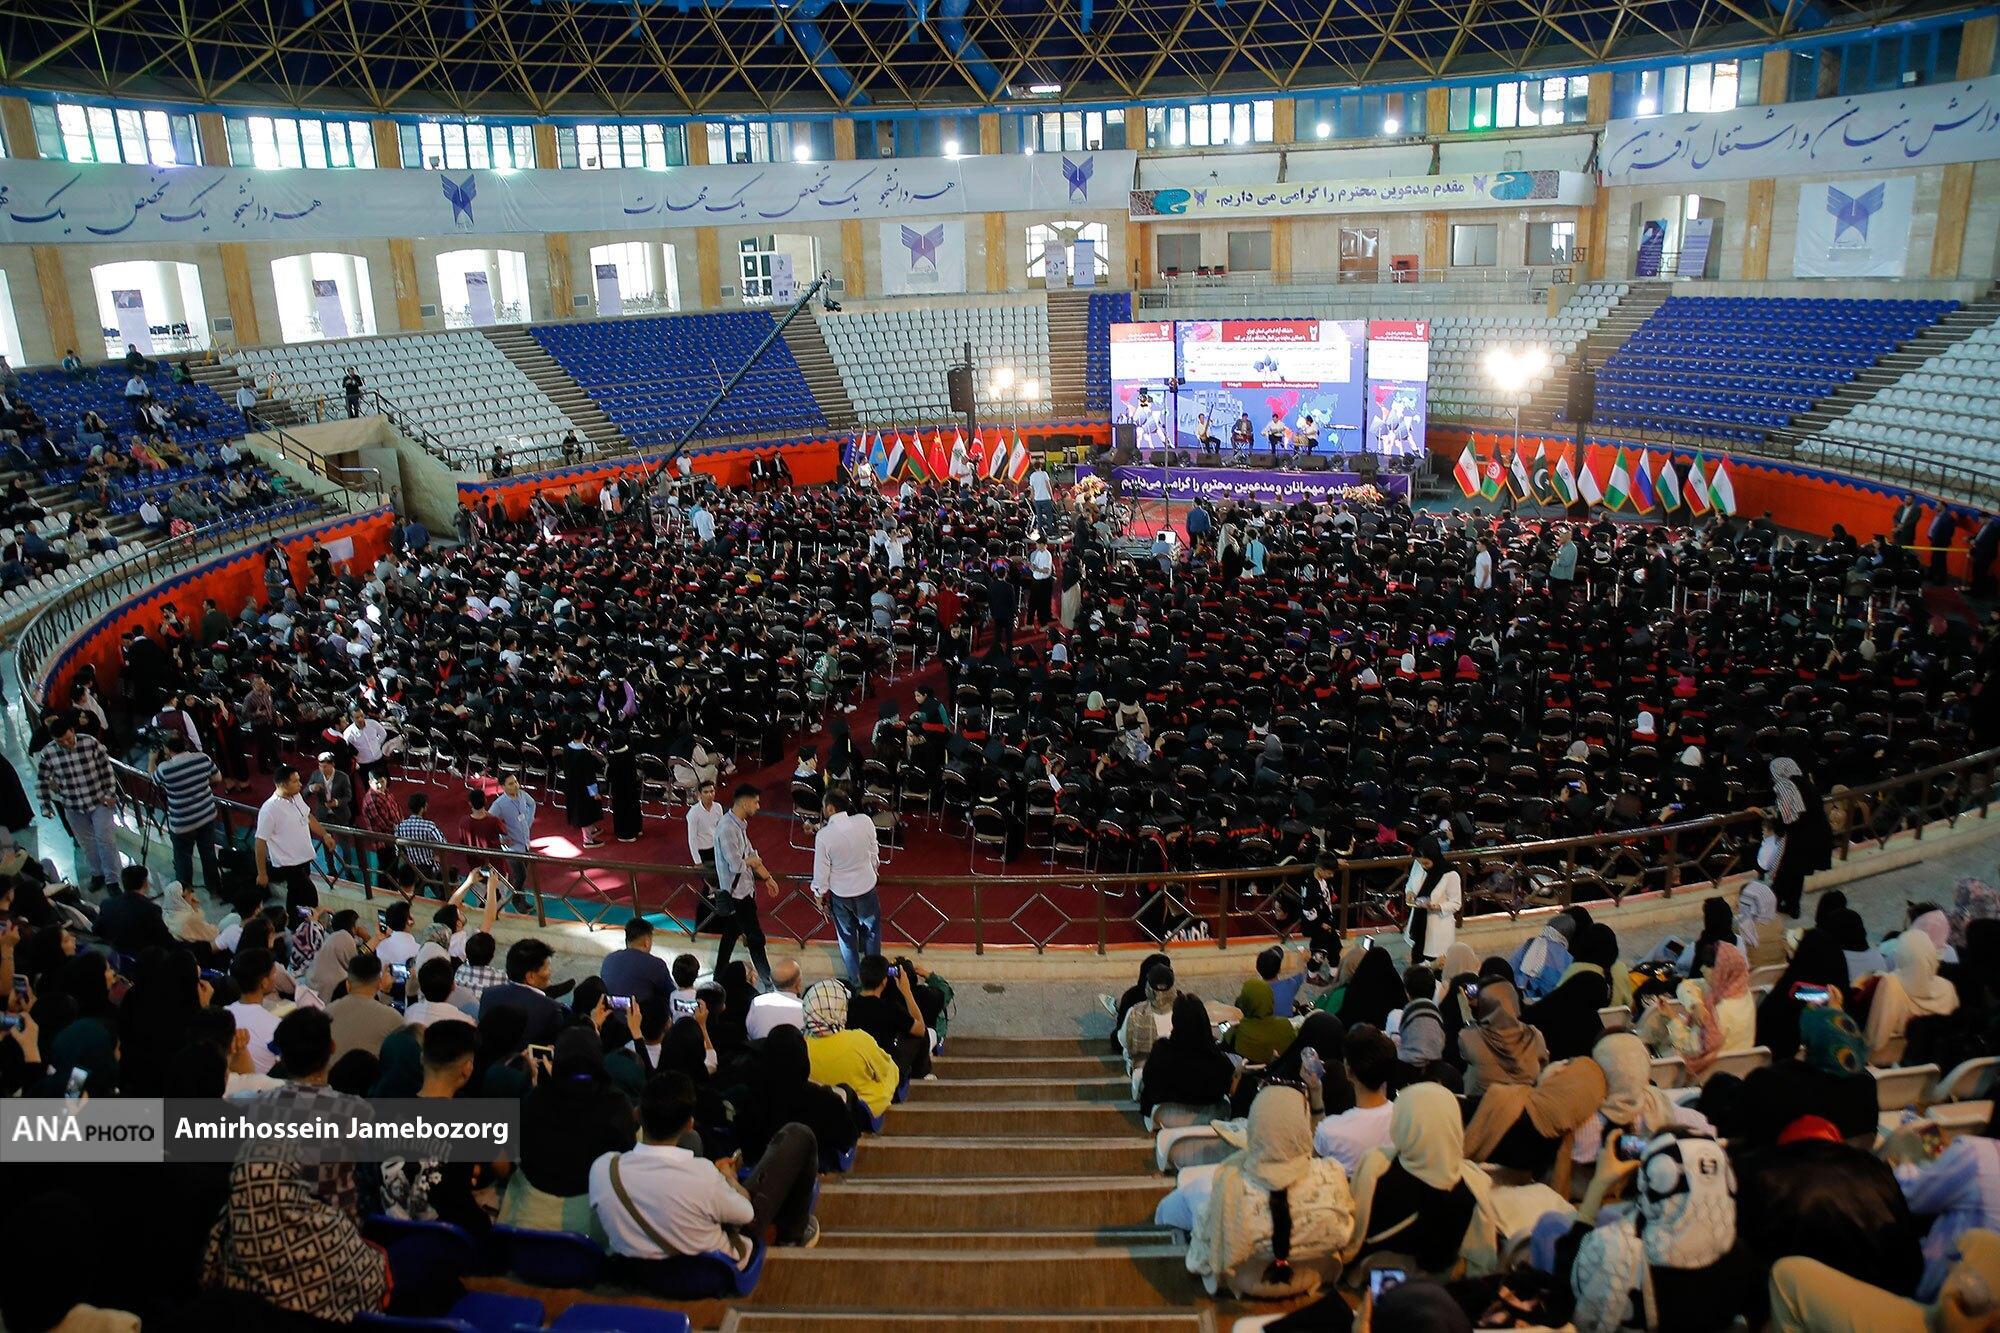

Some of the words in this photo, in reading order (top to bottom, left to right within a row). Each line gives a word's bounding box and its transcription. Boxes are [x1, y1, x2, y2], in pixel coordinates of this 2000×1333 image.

[1608, 120, 1702, 177] آفرین
[1690, 108, 1798, 170] اشتغال
[705, 172, 764, 219] یک
[818, 166, 877, 213] یک
[878, 167, 909, 209] دانشجو
[909, 182, 955, 203] هر
[1257, 193, 1276, 205] می
[1280, 187, 1319, 204] گرامی
[1323, 186, 1334, 202] را
[1338, 186, 1377, 201] محترم
[1380, 184, 1429, 199] مدعوین
[1433, 180, 1465, 197] مقدم
[10, 172, 82, 235] یک
[160, 174, 226, 232] یک
[233, 177, 269, 228] دانشجو
[270, 199, 322, 223] هر
[623, 186, 708, 215] مهارت
[1192, 478, 1200, 493] را
[1201, 479, 1232, 493] محترم
[1284, 480, 1325, 497] مهمانان
